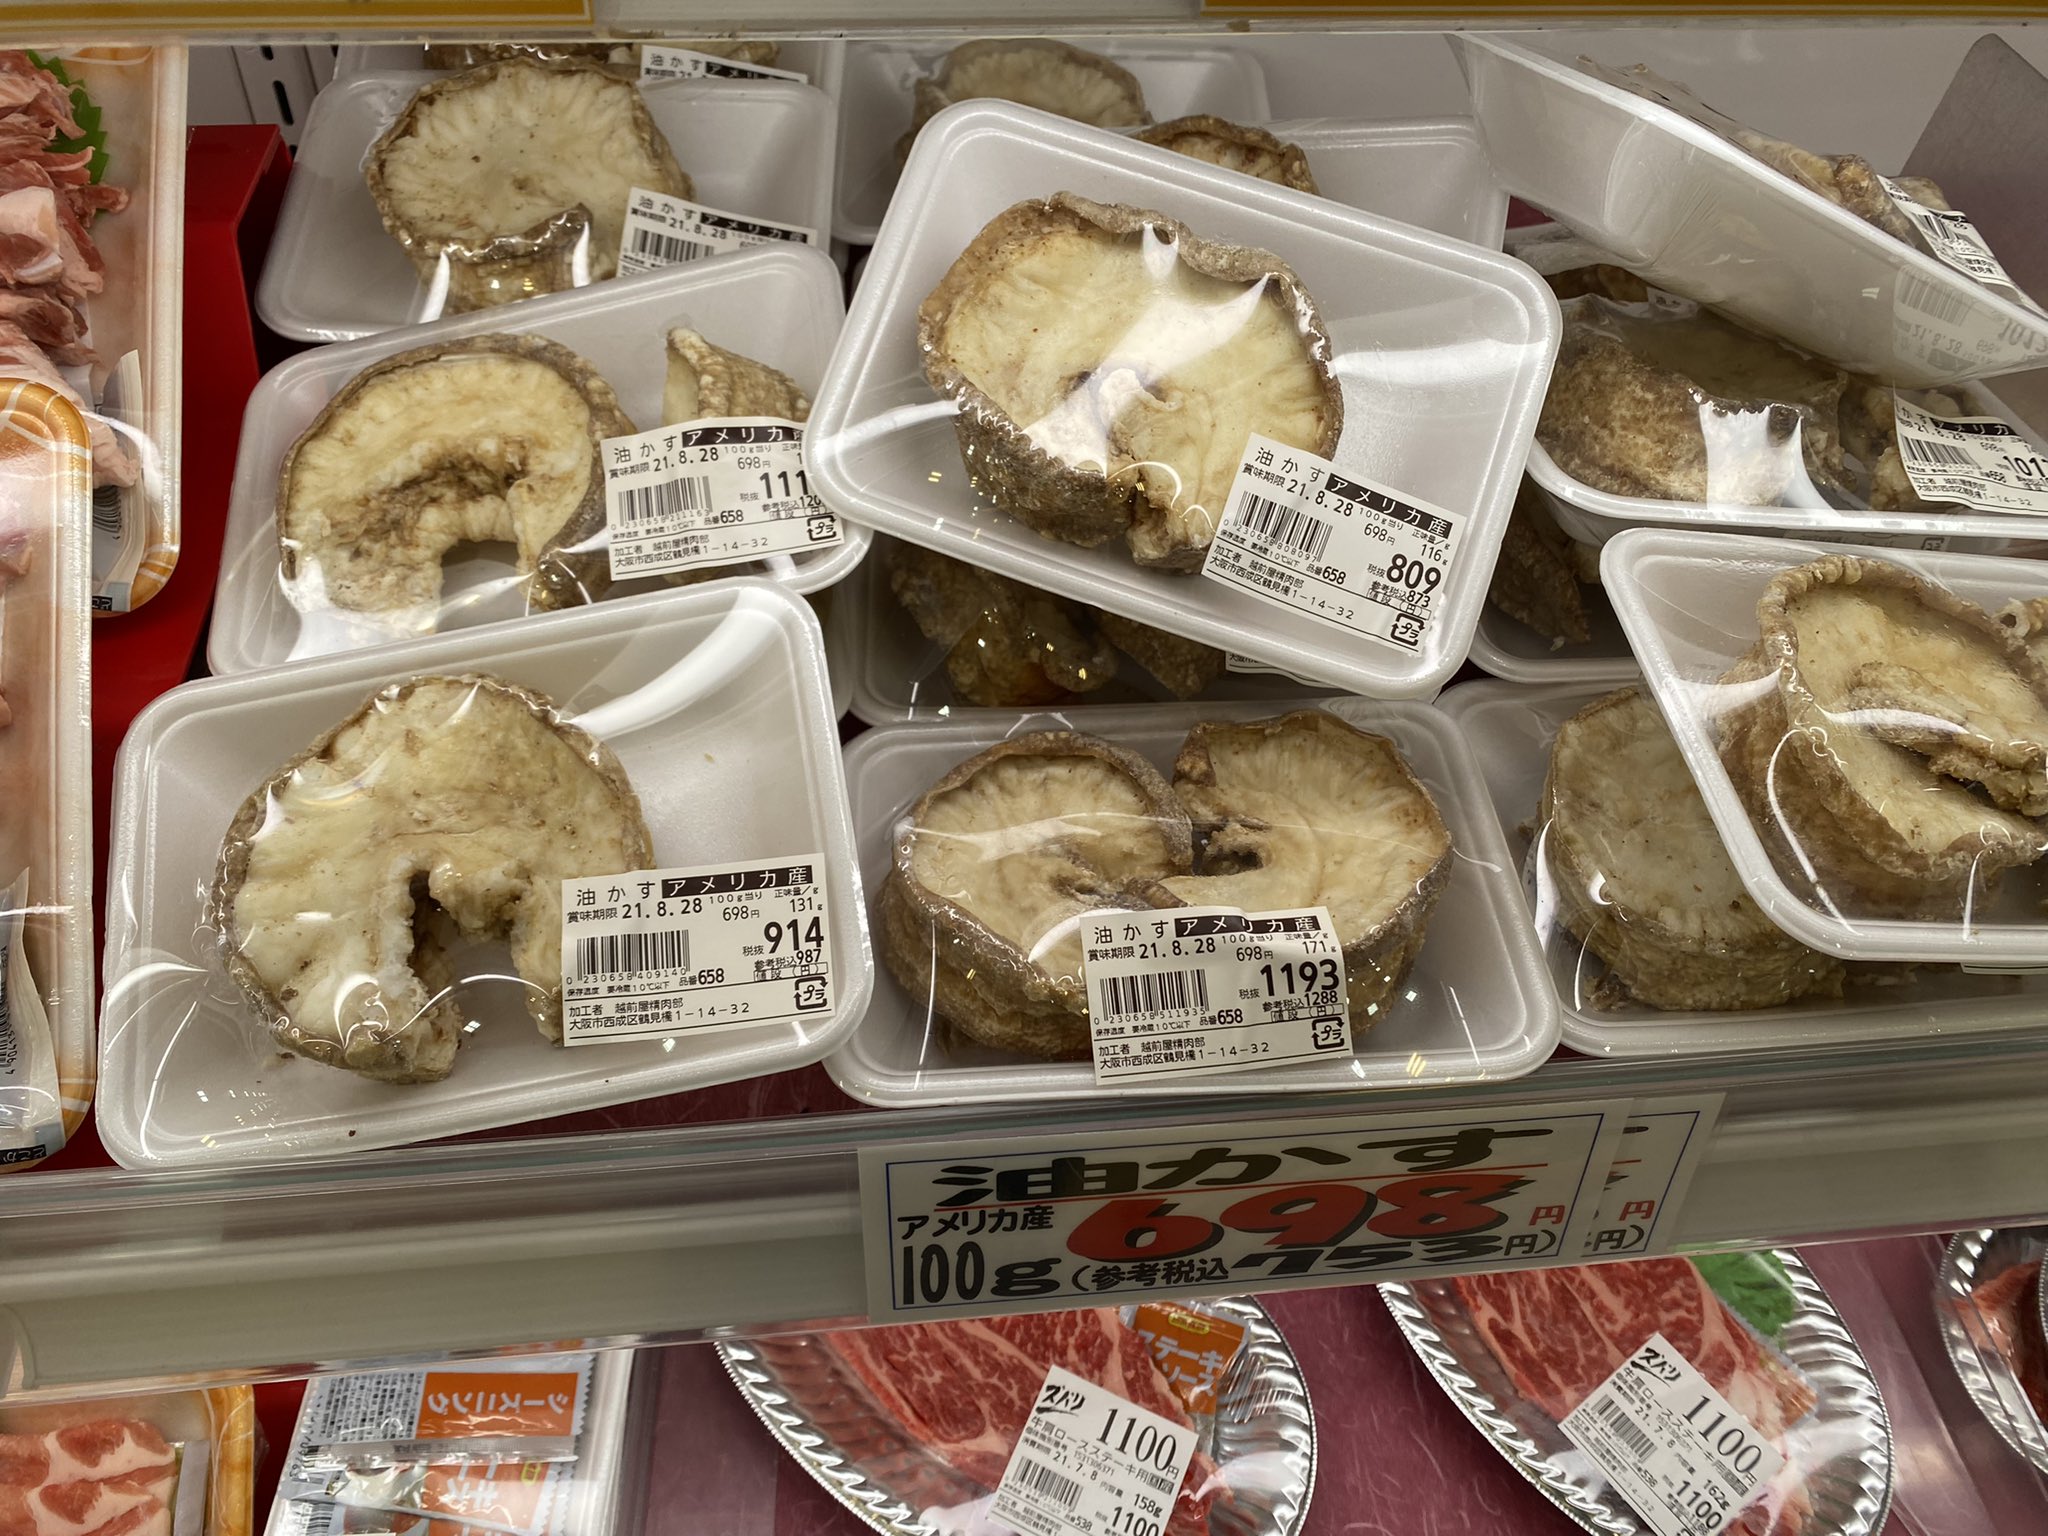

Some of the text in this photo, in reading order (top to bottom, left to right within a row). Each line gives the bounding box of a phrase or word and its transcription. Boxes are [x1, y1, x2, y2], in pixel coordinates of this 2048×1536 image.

[669, 218, 727, 240] 21.8.28
[614, 435, 677, 463] 油かす
[609, 448, 719, 479] 賞味期限 21.8.28
[1241, 463, 1354, 516] 賞味期限 21.8.28
[1255, 446, 1448, 535] 油かす アメリカ産
[615, 545, 642, 556] 加工者
[1213, 544, 1241, 563] 加工者
[1367, 553, 1441, 595] 税抜 809
[1399, 621, 1419, 639] プラ
[576, 867, 808, 906] 油かす アメリカ産
[567, 898, 702, 924] 賞味期限 21.8.28
[742, 916, 824, 956] 税抜 914
[1095, 916, 1316, 944] 油かす アメリカ産
[797, 949, 821, 964] 987
[1088, 937, 1216, 962] 賞味期限 21.8.28
[698, 968, 724, 985] 658
[1239, 959, 1339, 999] 税抜 1193
[804, 985, 825, 1001] プラ
[1304, 991, 1338, 1006] 1288
[569, 998, 684, 1018] 加工者 越前屋精肉部
[1217, 1009, 1243, 1025] 658
[1320, 1025, 1341, 1041] プラ
[1099, 1037, 1205, 1057] 加工者 越前屋精肉部
[932, 1127, 1553, 1207] 油かす
[897, 1204, 1055, 1241] アメリカ産
[902, 1241, 1062, 1306] 100g
[1639, 1347, 1682, 1382] ズバリ
[427, 1390, 569, 1417] シーズニング
[1042, 1385, 1086, 1412] ズバリ
[1133, 1493, 1163, 1518] 158g
[1676, 1480, 1722, 1530] 1100
